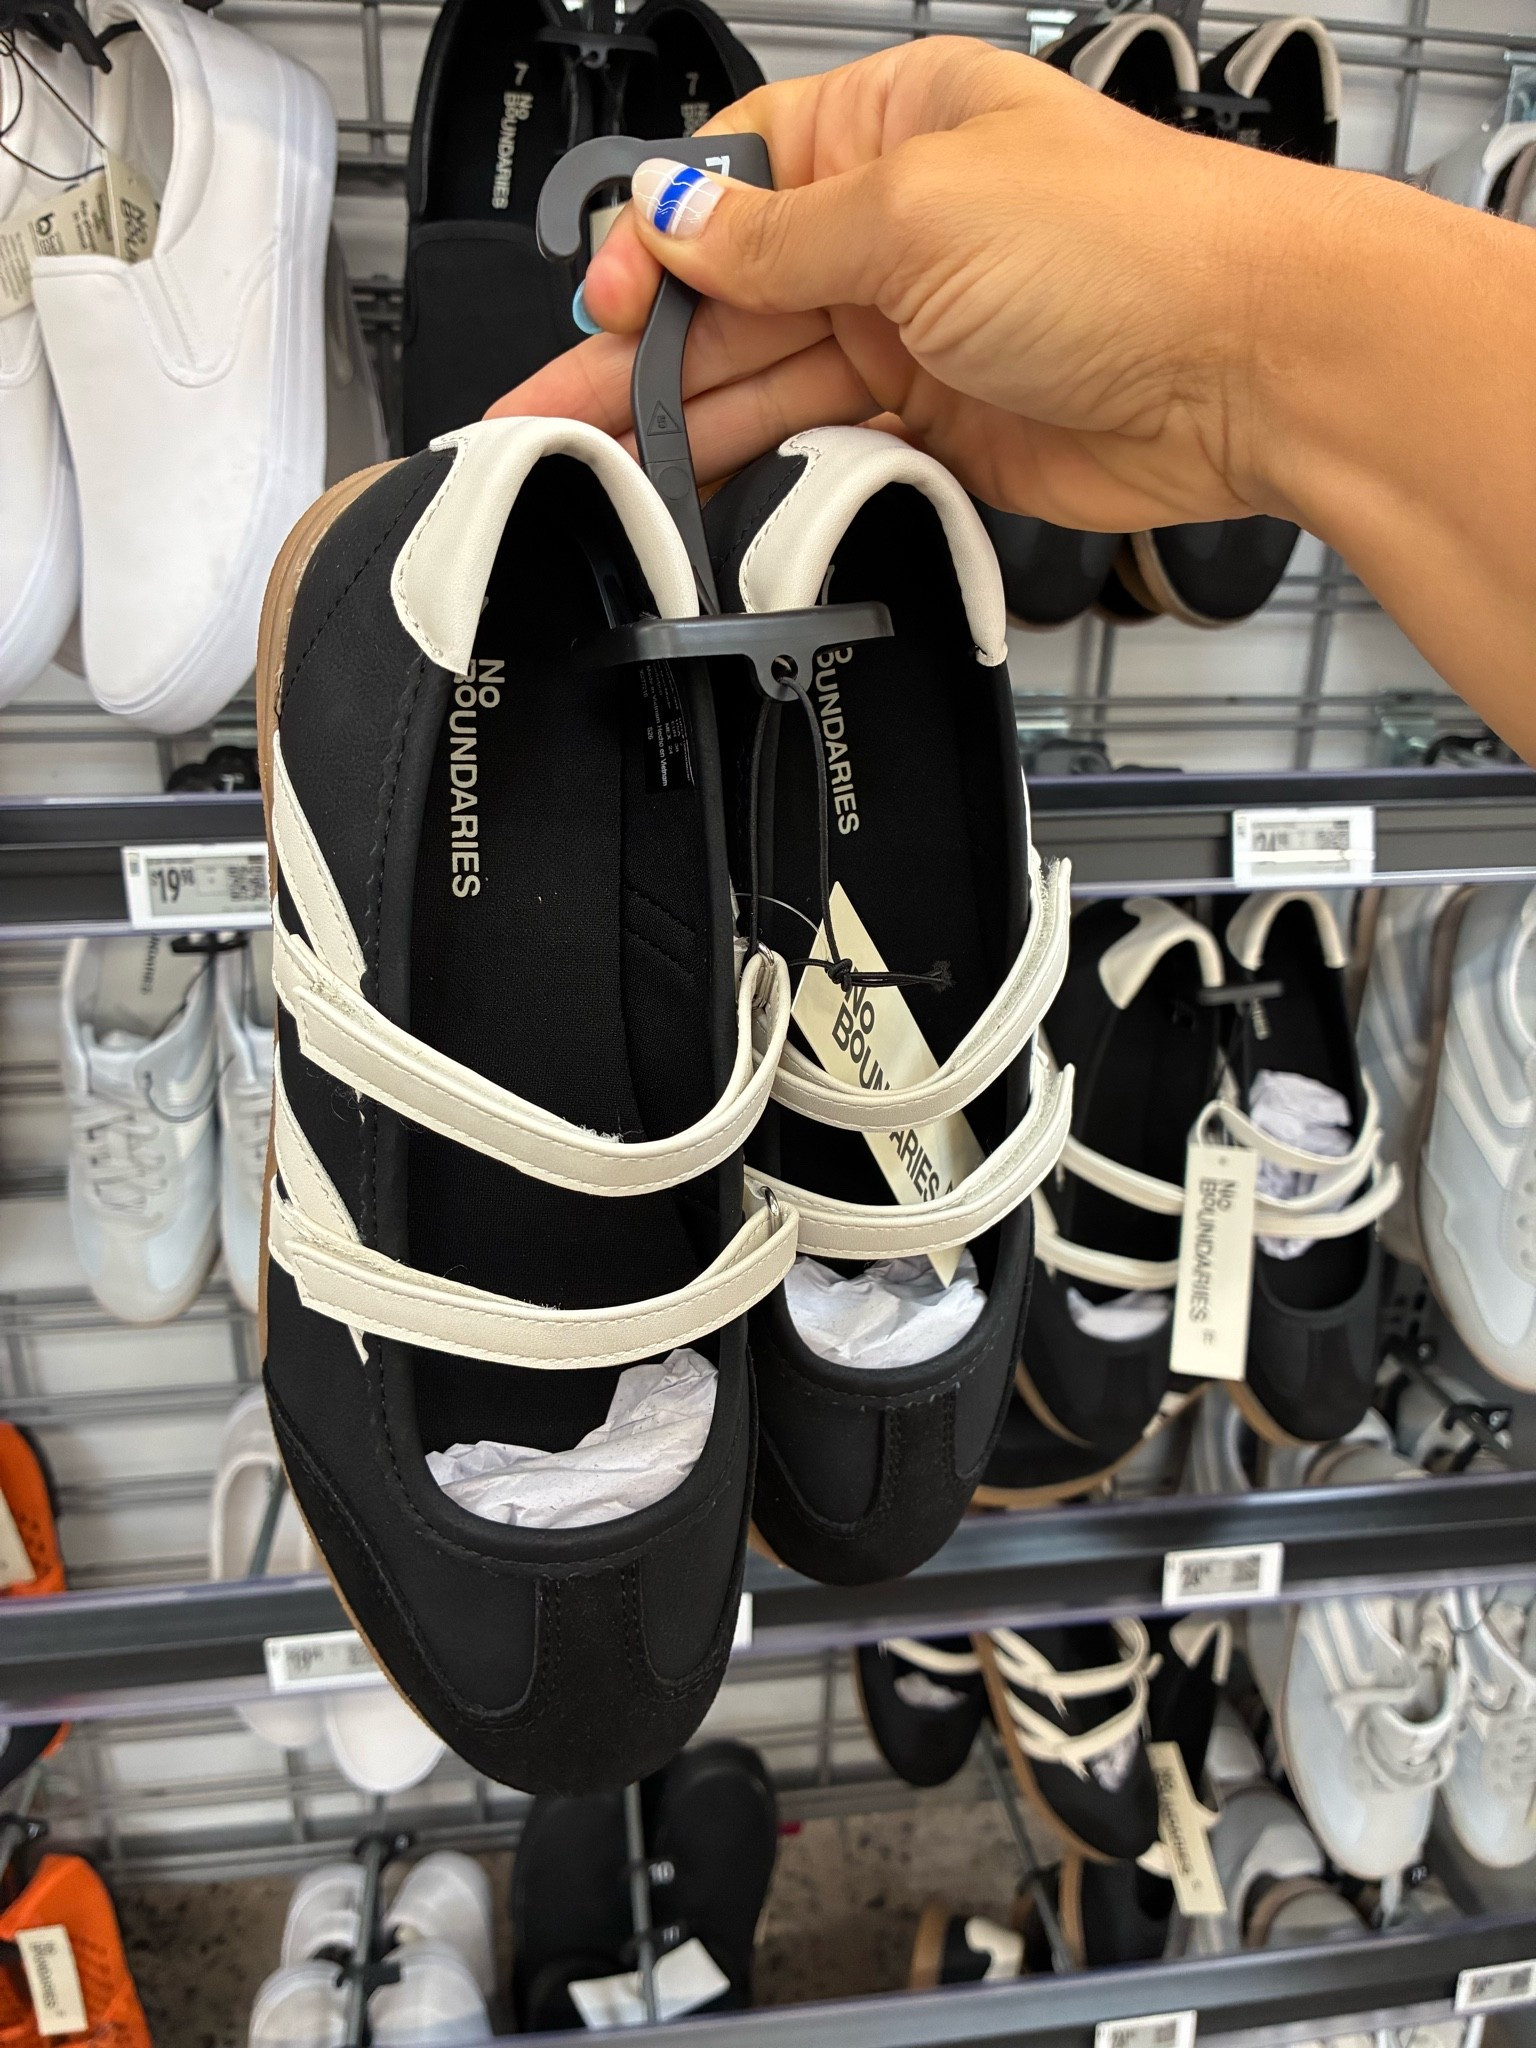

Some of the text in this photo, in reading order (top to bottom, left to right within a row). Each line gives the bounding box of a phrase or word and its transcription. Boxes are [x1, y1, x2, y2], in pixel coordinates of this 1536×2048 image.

[478, 659, 506, 708] NO
[657, 724, 665, 747] Hecho
[815, 652, 859, 835] OUNDARIES
[1216, 1179, 1238, 1212] NO
[1189, 1177, 1217, 1323] BOUNDARIES
